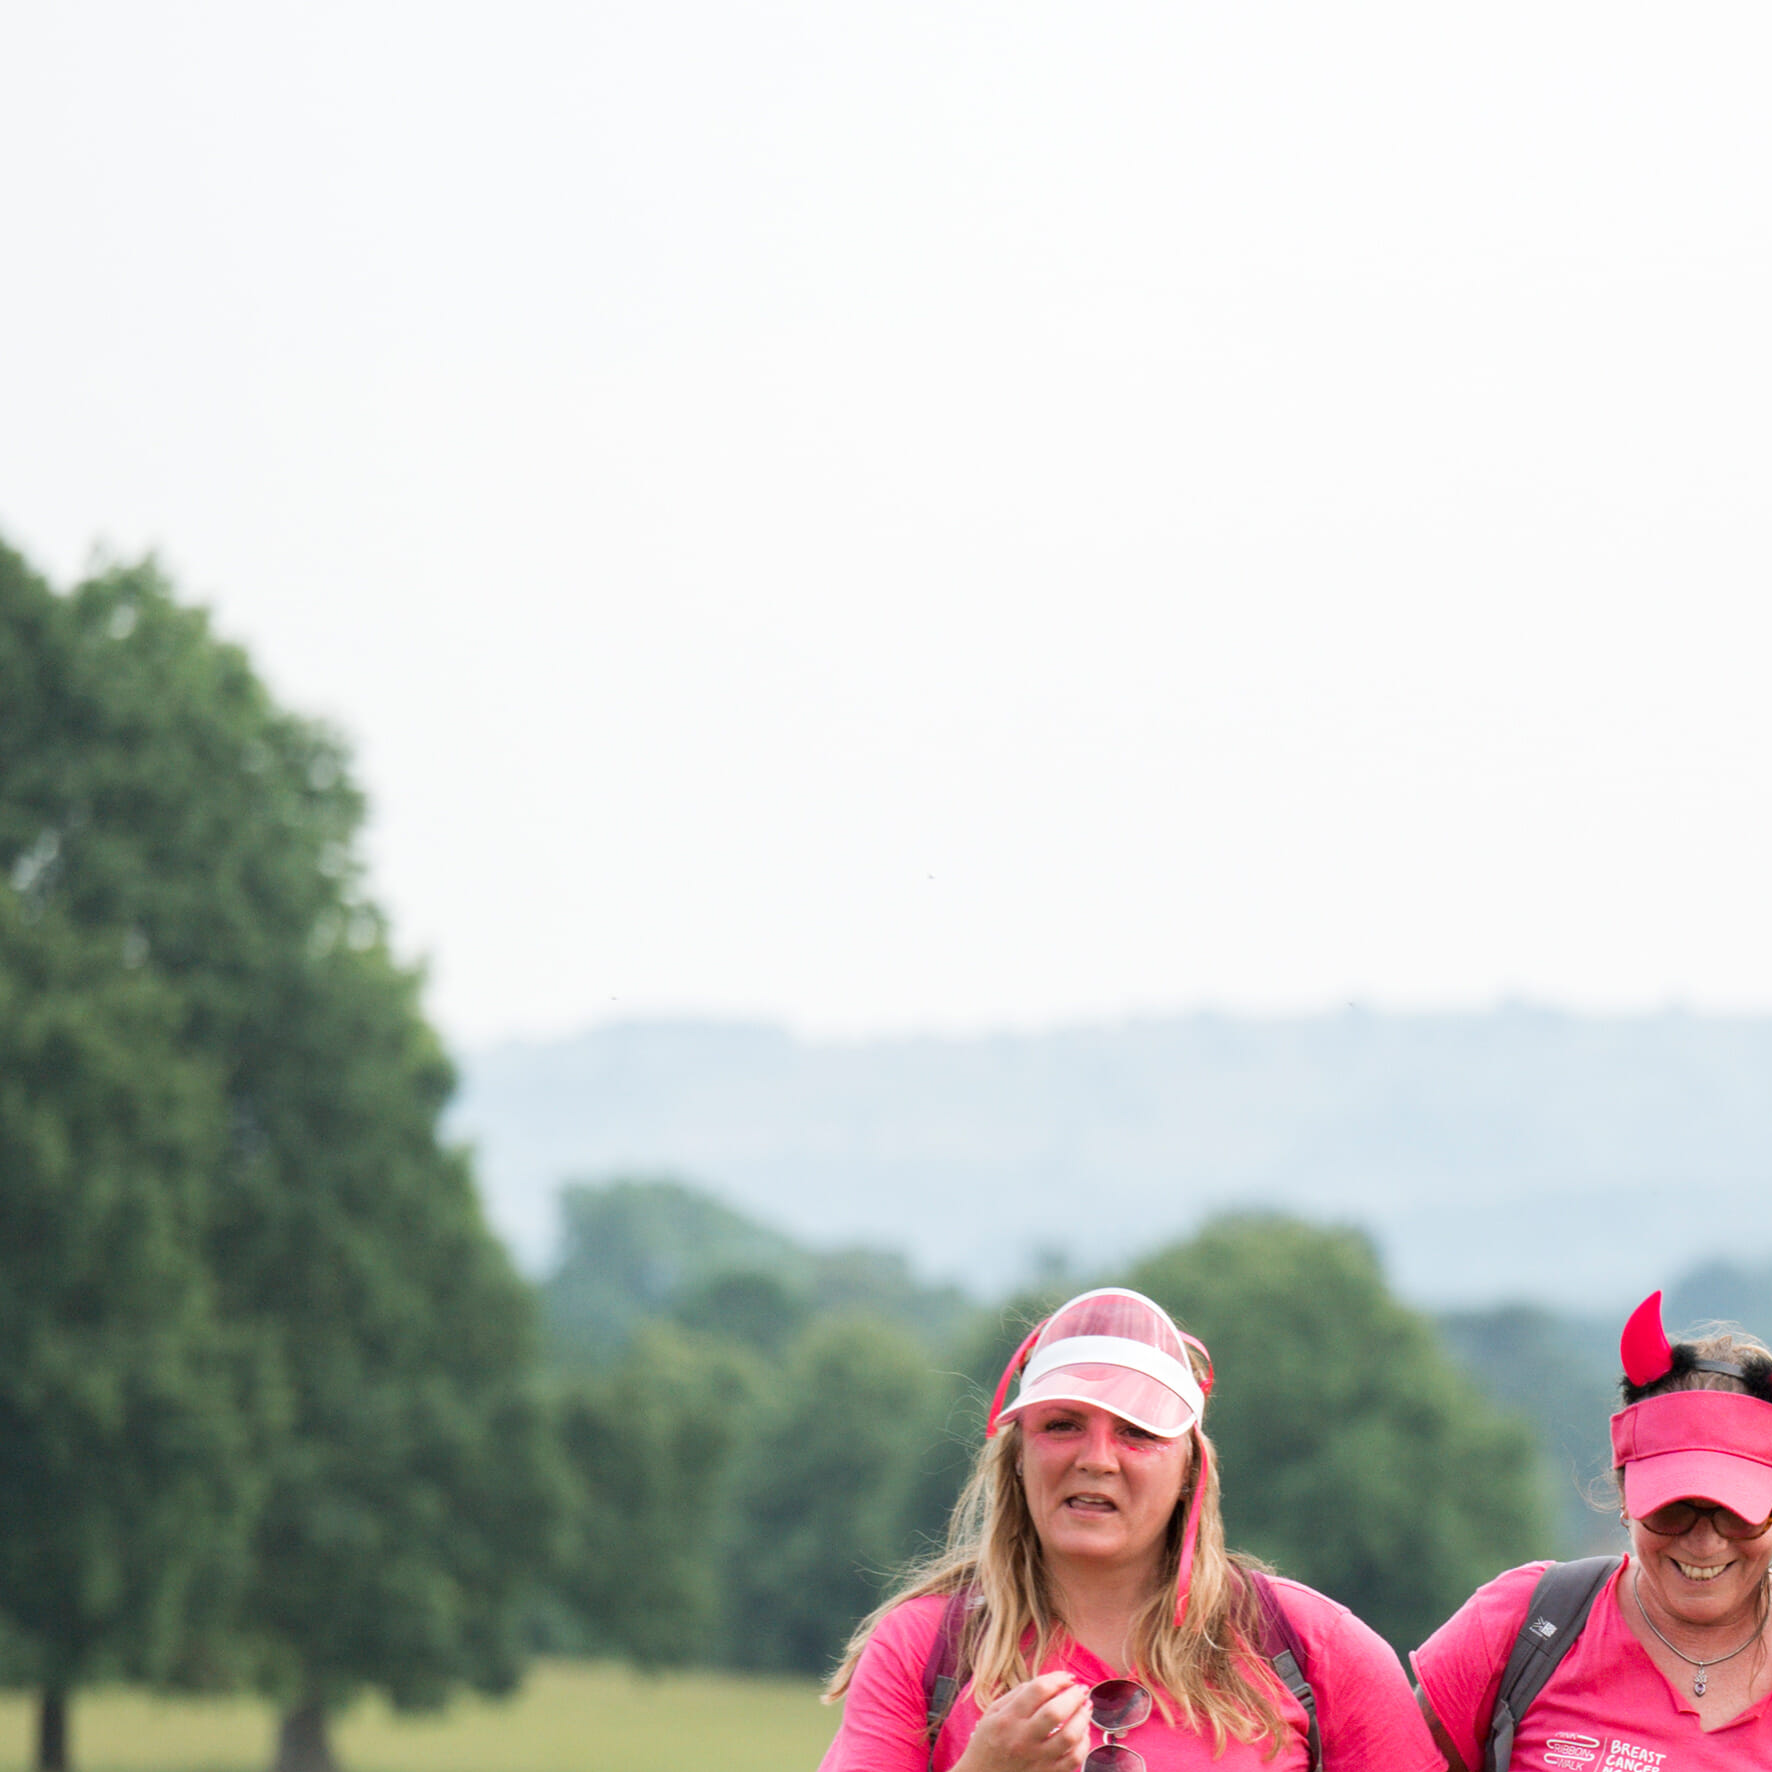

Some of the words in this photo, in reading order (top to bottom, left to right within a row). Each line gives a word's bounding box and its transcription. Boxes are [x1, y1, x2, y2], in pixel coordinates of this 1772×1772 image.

[1554, 1743, 1592, 1758] RIBBON
[1611, 1740, 1667, 1766] BREAST
[1556, 1758, 1585, 1772] WALK
